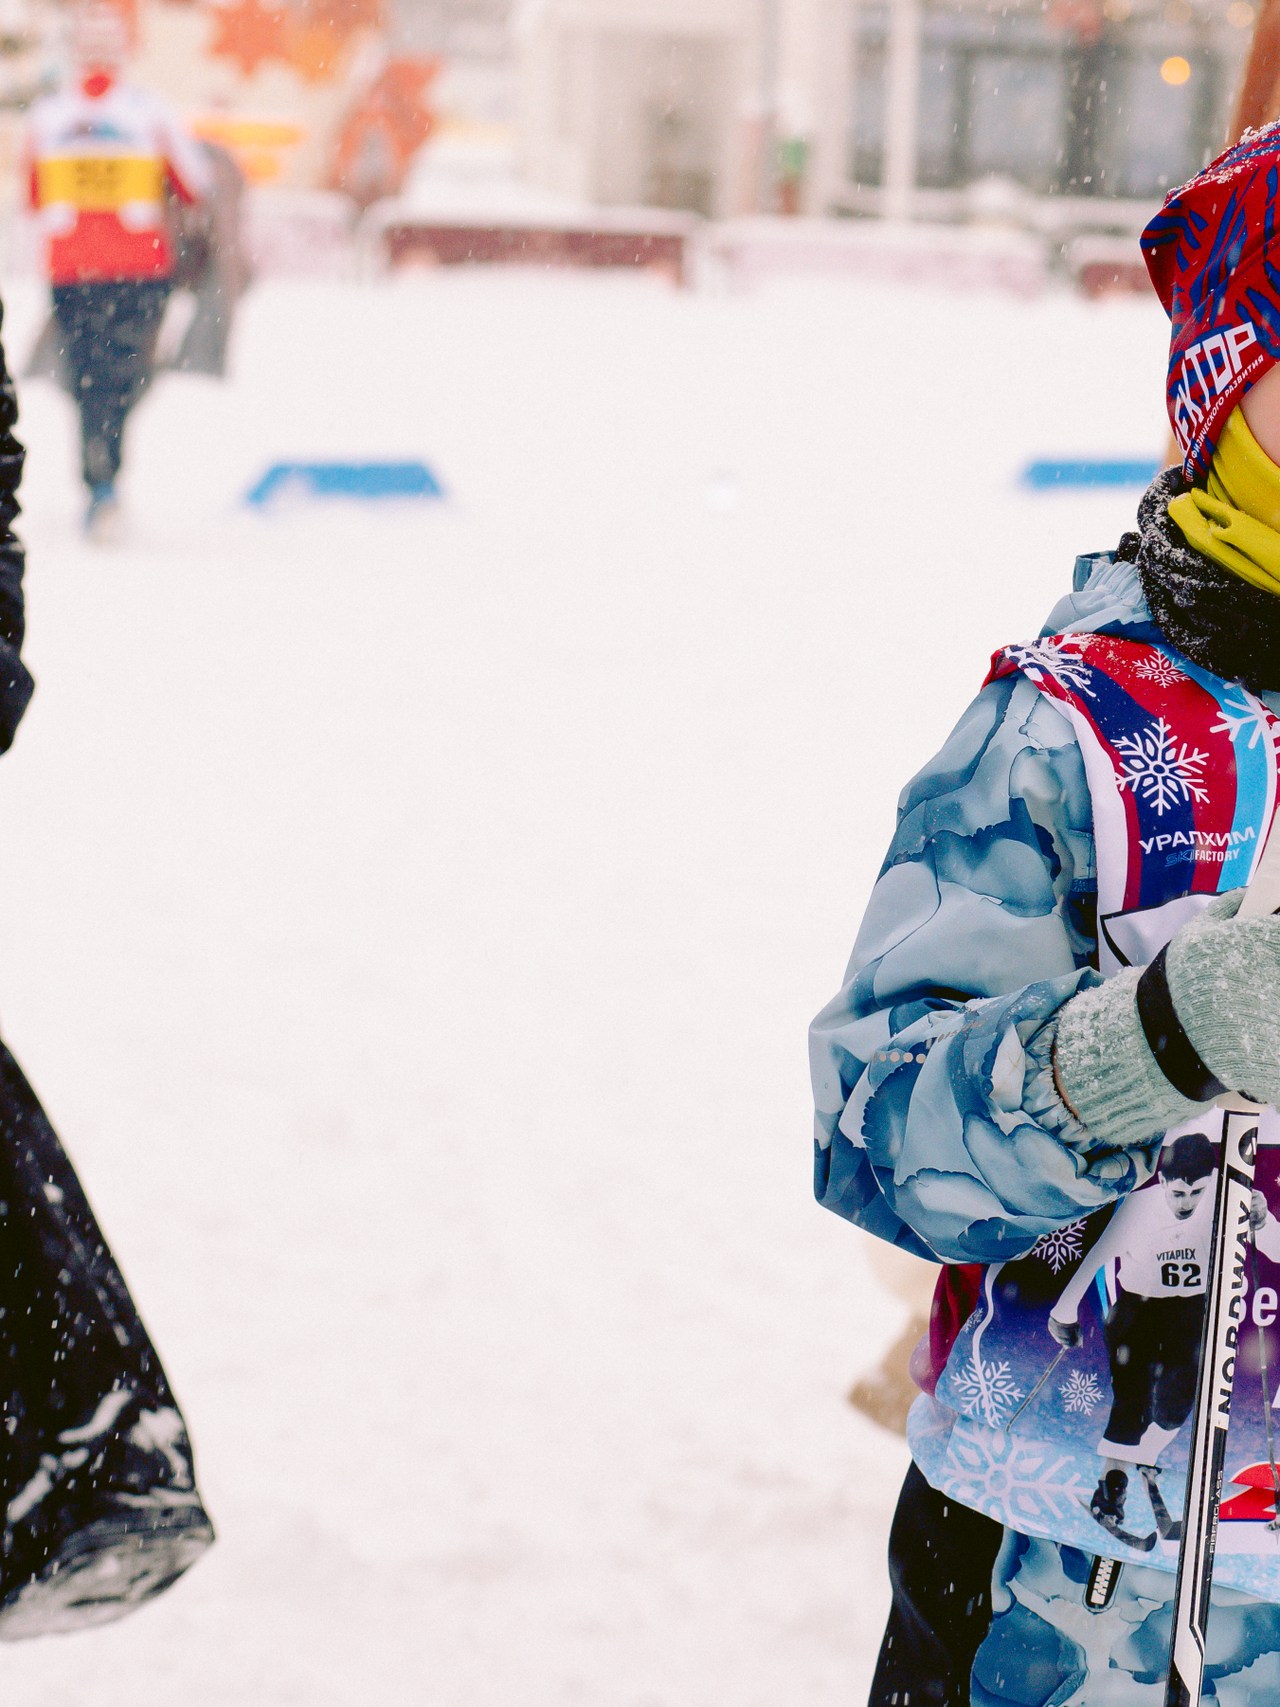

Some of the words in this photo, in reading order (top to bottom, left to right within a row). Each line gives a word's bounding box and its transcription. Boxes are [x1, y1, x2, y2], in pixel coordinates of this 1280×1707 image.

[1190, 396, 1225, 460] ФИЗИЧЕСКОГО
[1223, 354, 1265, 398] РАЗВИТИЯ
[1137, 825, 1256, 855] УРАЛХИМ
[1194, 847, 1241, 863] FACTORY
[1156, 1247, 1197, 1261] VITAPLEX
[1161, 1262, 1202, 1288] 62
